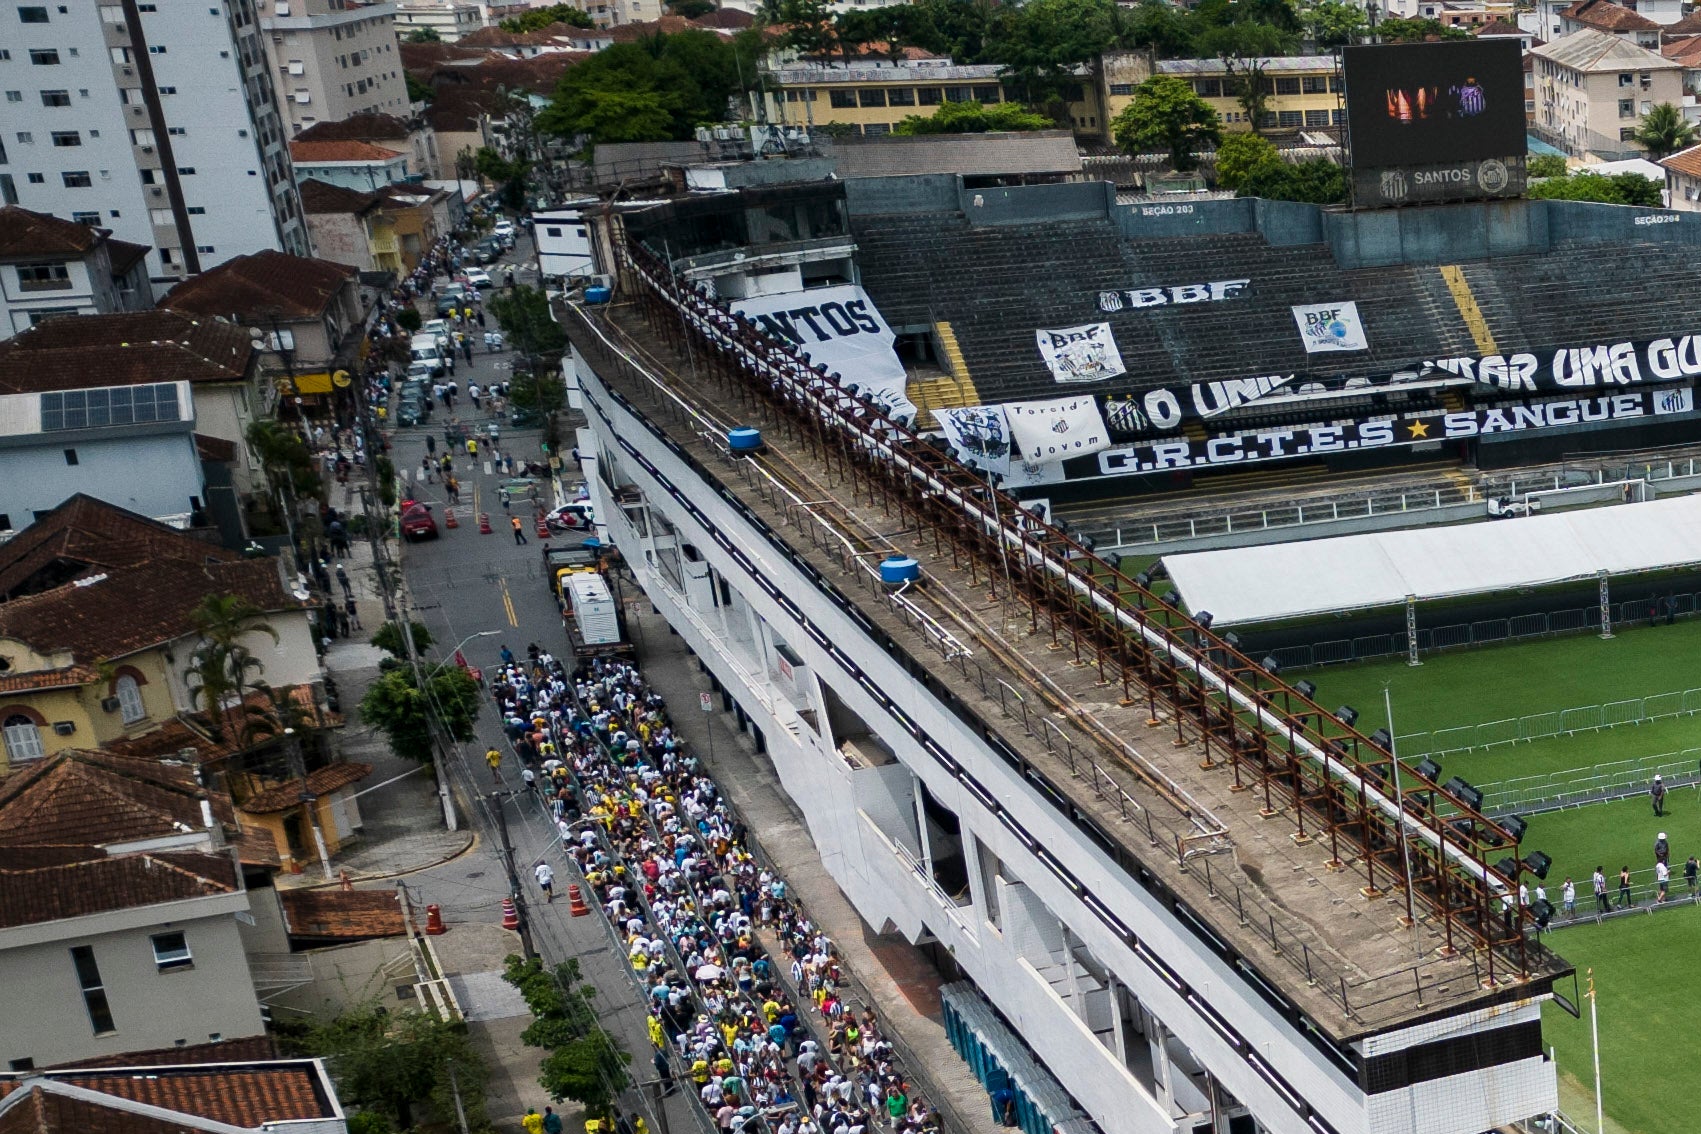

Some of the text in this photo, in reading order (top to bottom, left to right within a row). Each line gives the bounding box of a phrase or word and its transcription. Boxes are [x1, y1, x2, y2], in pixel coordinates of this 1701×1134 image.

[1414, 168, 1471, 184] SANTOS
[1124, 279, 1251, 308] BBF
[757, 299, 881, 344] NTOS
[1303, 309, 1342, 325] BBF
[1144, 388, 1182, 430] O
[1553, 342, 1643, 386] UMA
[1033, 435, 1099, 459] Jovem
[1098, 420, 1395, 475] G.R.C.T.E.S
[1445, 394, 1644, 437] SANGUE
